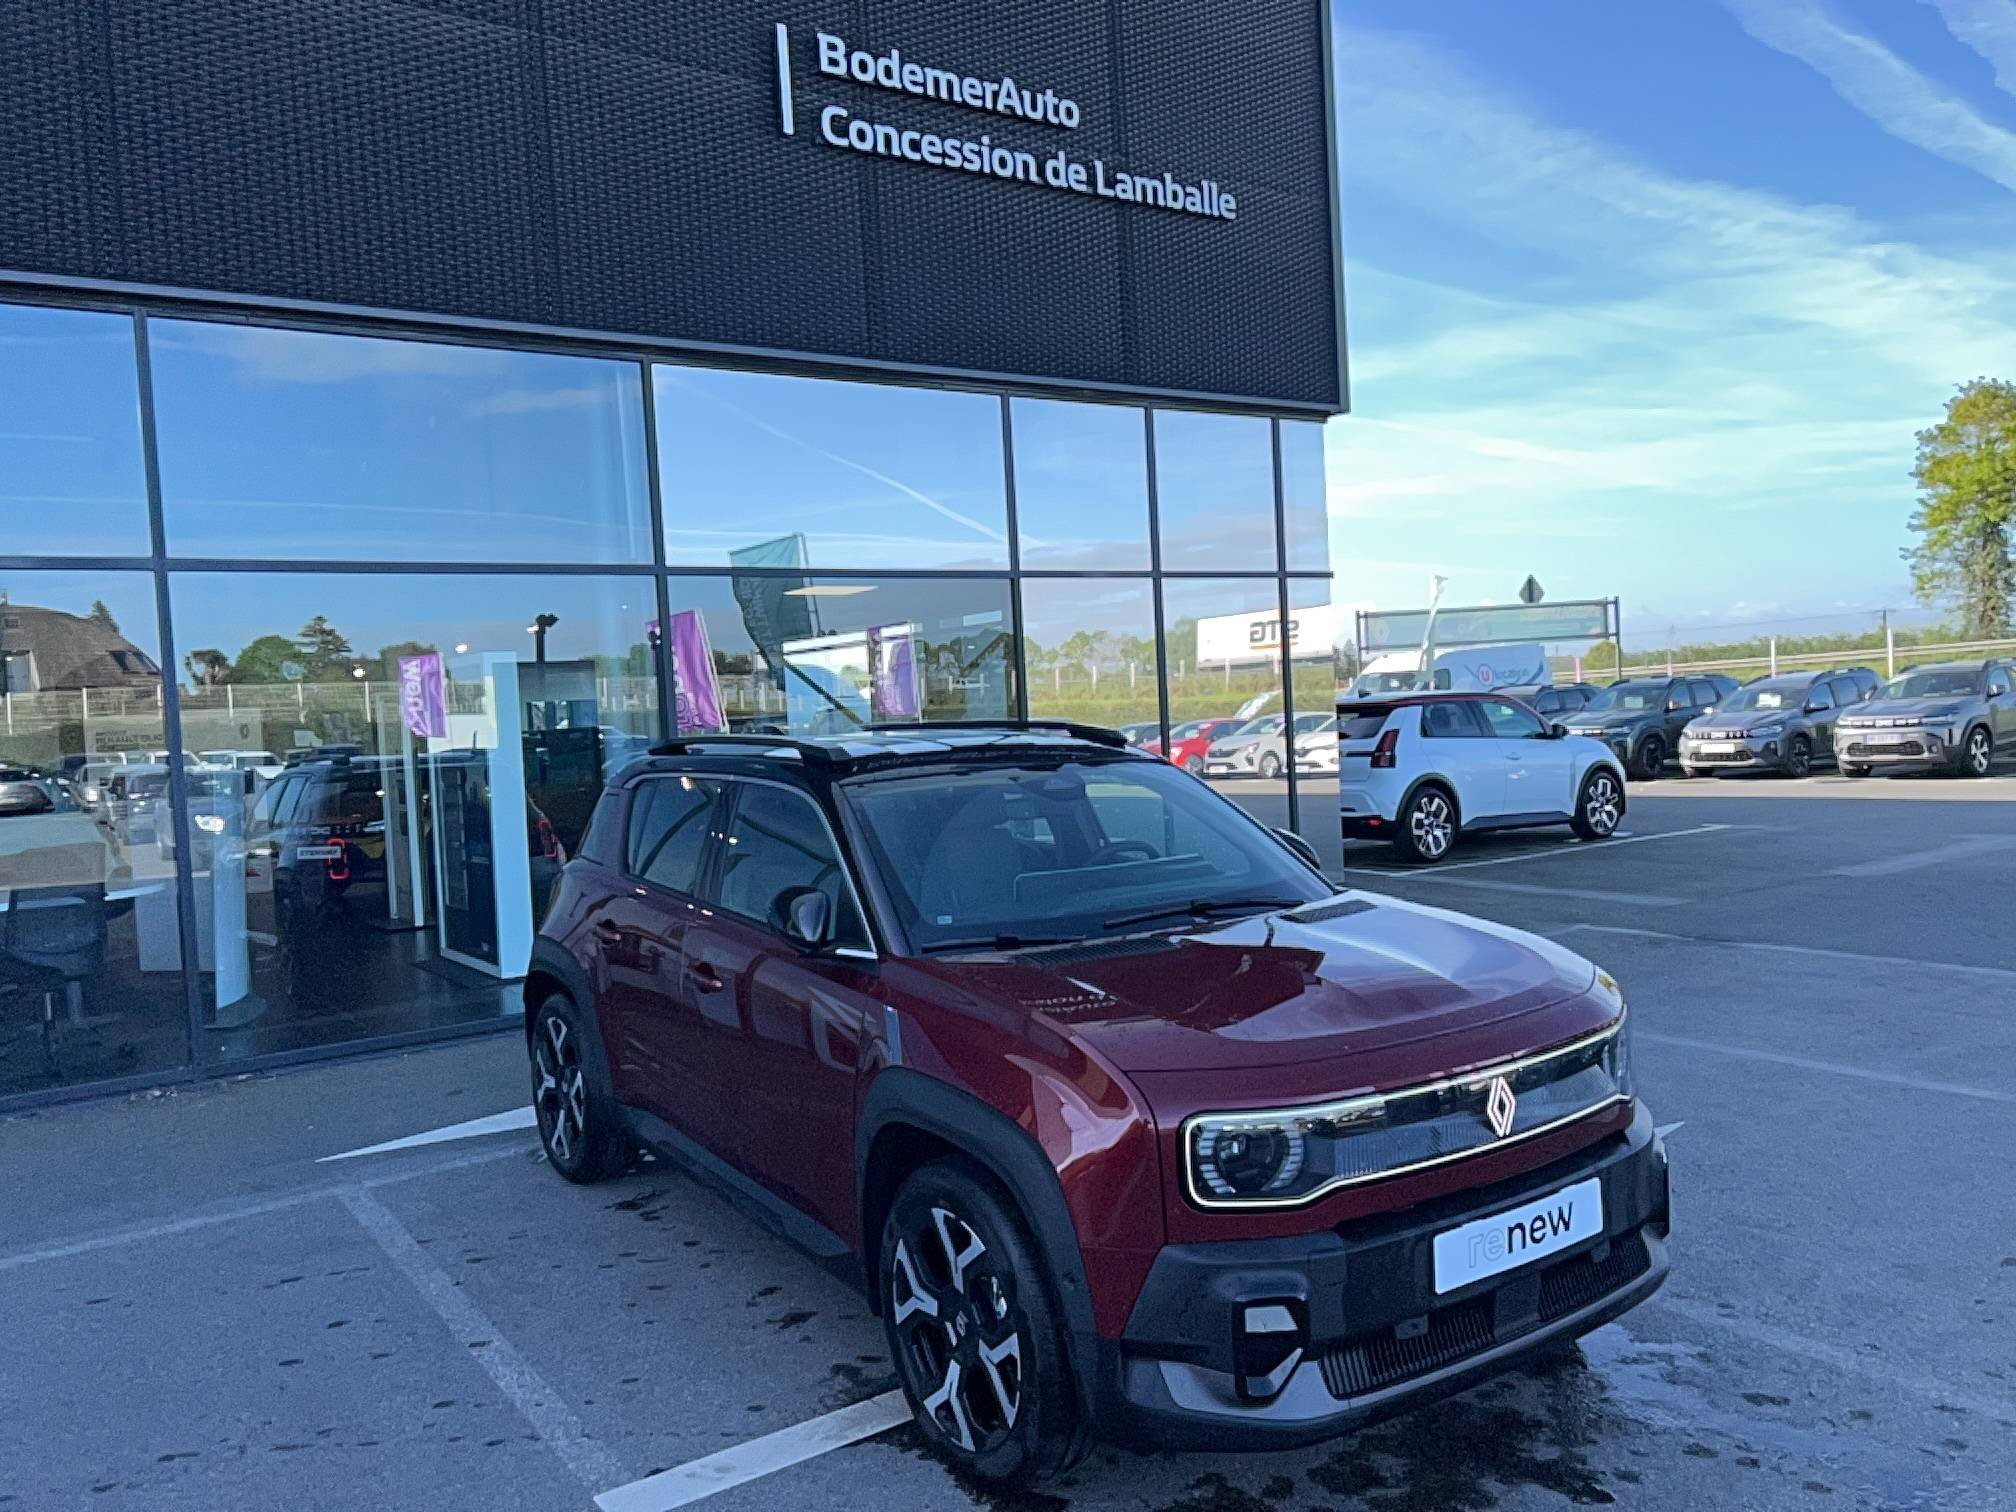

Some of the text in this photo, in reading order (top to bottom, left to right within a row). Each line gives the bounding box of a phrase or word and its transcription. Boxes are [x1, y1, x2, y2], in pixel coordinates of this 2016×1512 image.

[817, 32, 1081, 129] BodemerAuto
[820, 105, 1238, 220] Concession de Lamballe
[1467, 1201, 1574, 1268] renew
